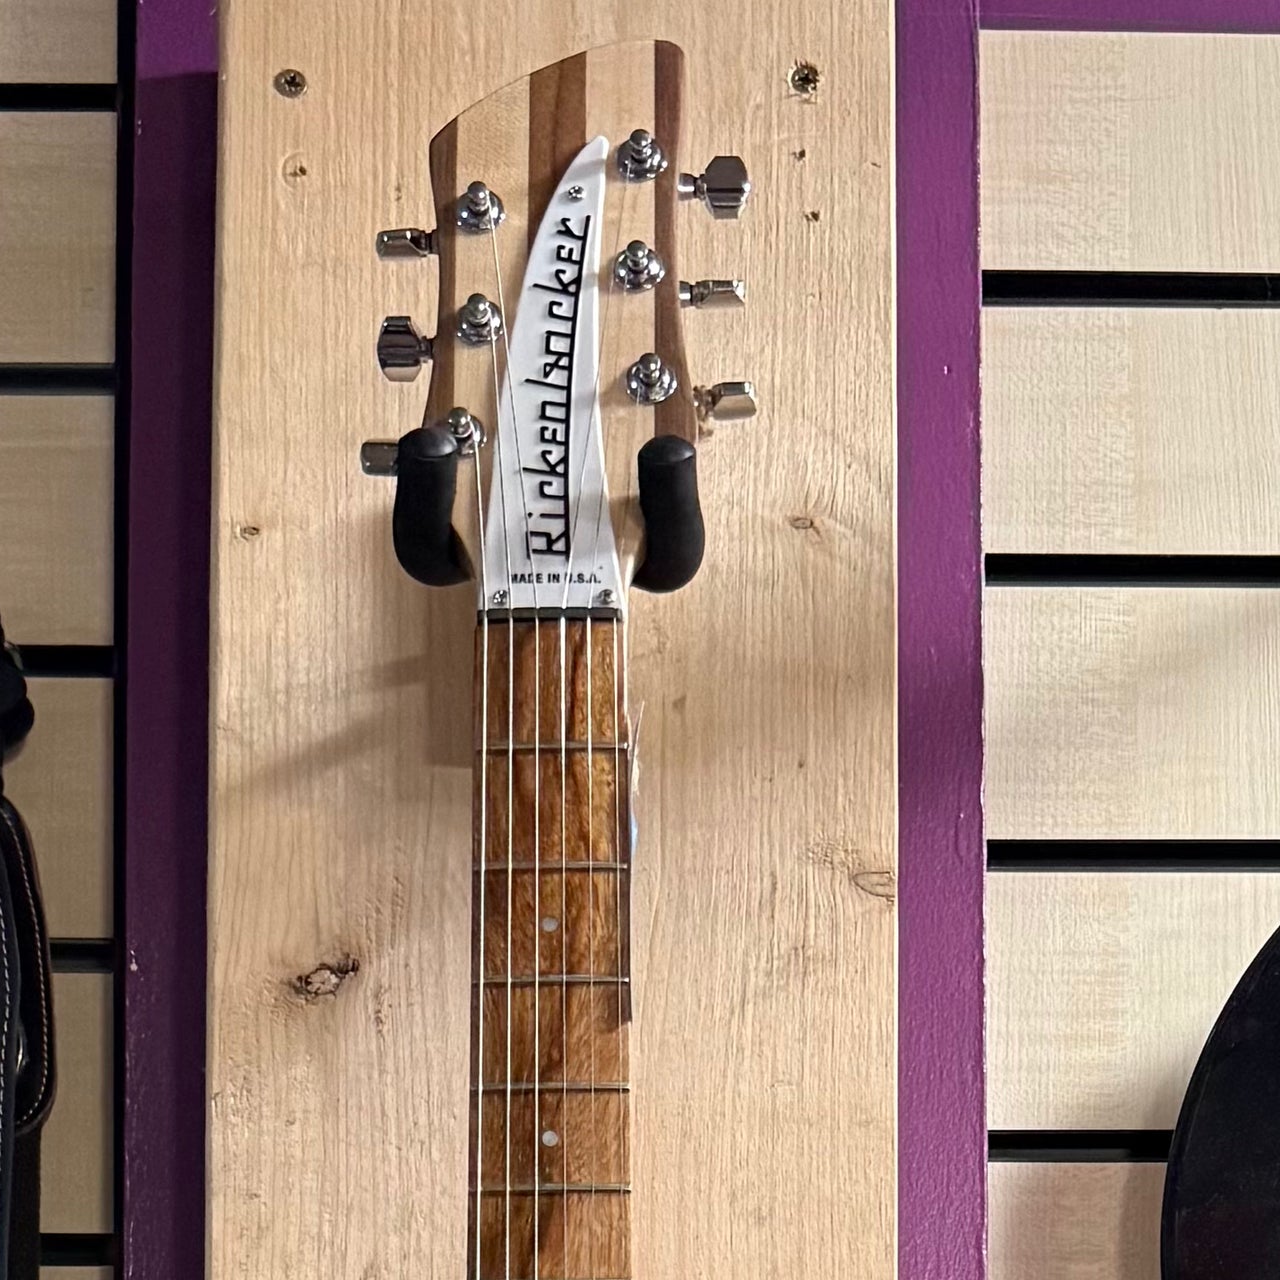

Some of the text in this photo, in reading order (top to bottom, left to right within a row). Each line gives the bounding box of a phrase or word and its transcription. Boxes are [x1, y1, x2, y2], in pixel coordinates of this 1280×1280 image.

[519, 215, 591, 560] Rickenbacker
[511, 573, 543, 584] MADE
[547, 573, 560, 584] IN
